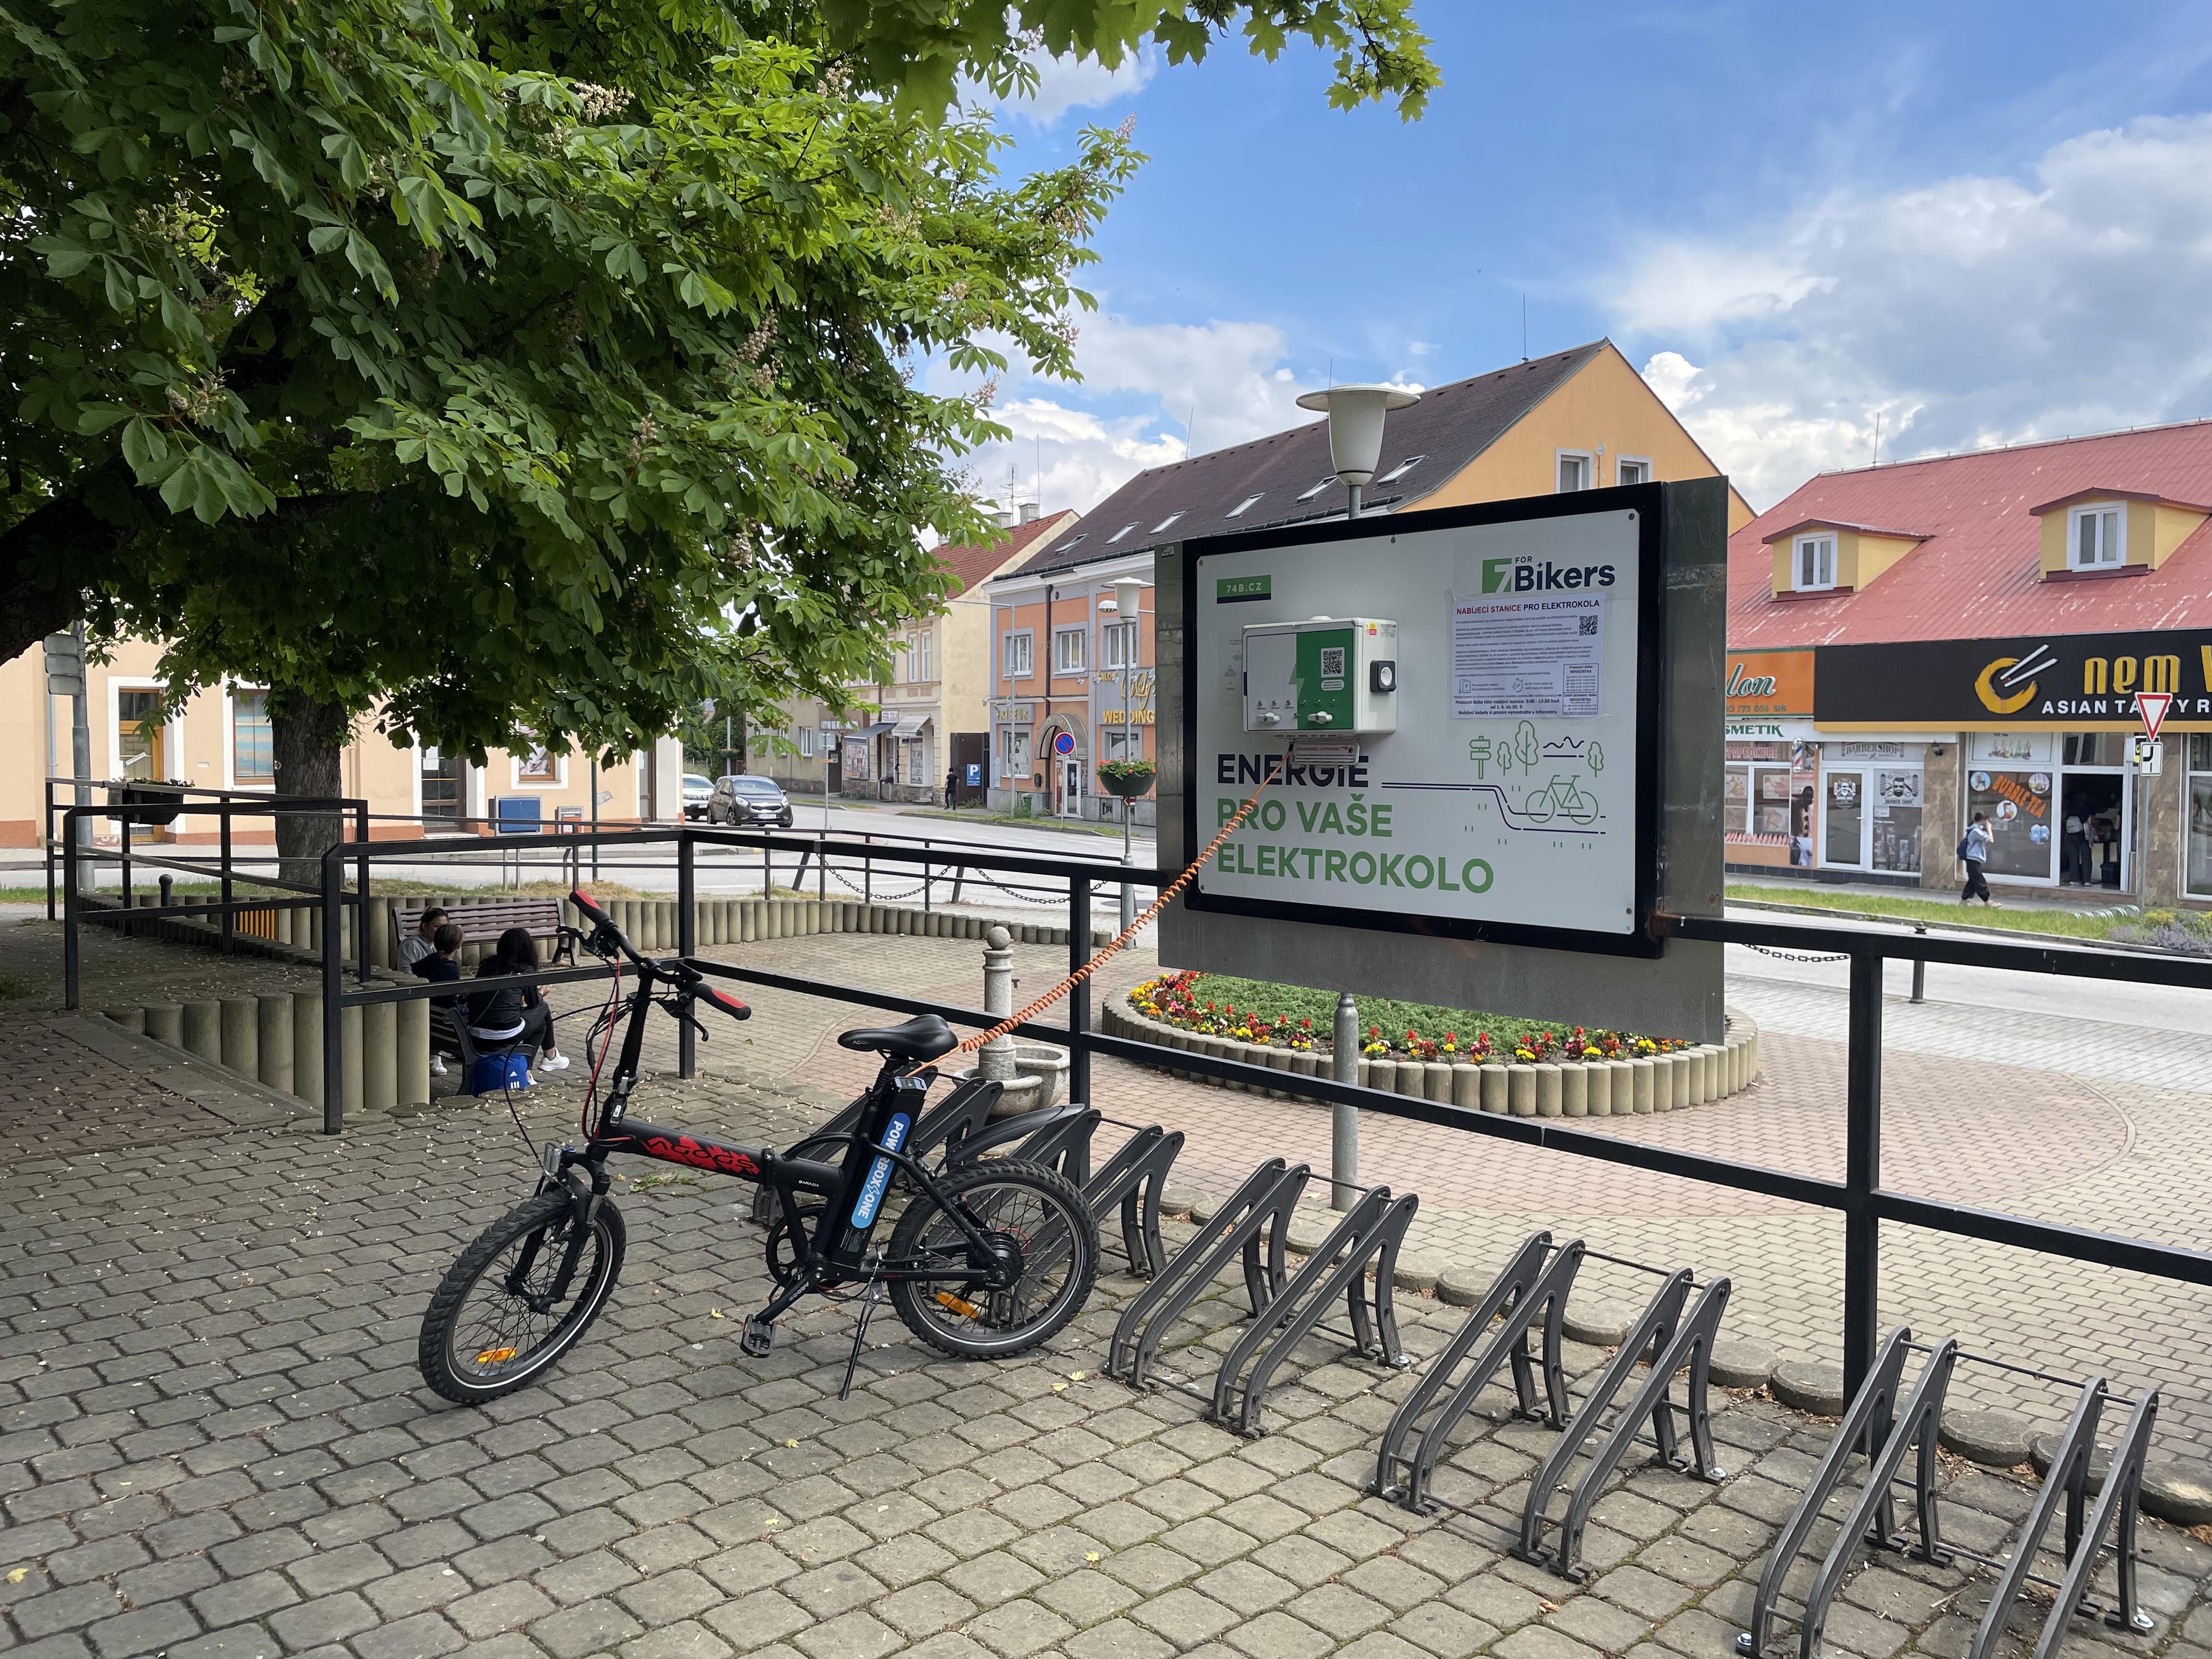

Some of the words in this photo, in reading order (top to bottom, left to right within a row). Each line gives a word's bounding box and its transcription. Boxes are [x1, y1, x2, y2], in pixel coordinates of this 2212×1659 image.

[1226, 582, 1262, 593] 74B.CZ
[1515, 561, 1615, 592] Bikers
[1457, 604, 1489, 615] NABÍJECÍ
[1491, 604, 1521, 613] STANICE
[1542, 600, 1600, 610] ELEKTROKOLA
[2084, 655, 2180, 695] nem
[2042, 700, 2107, 714] ASIAN
[2114, 699, 2190, 714] TAY
[970, 765, 979, 776] P
[1218, 754, 1369, 787] ENERGIE
[1992, 774, 2031, 807] BUBBLE
[2026, 795, 2047, 818] TEA
[1218, 798, 1286, 831] PRO
[1296, 793, 1392, 837] VAŠE
[1217, 842, 1494, 894] ELEKTROKOLO
[870, 1120, 905, 1188] POWRBOX
[858, 1193, 875, 1219] ONE
